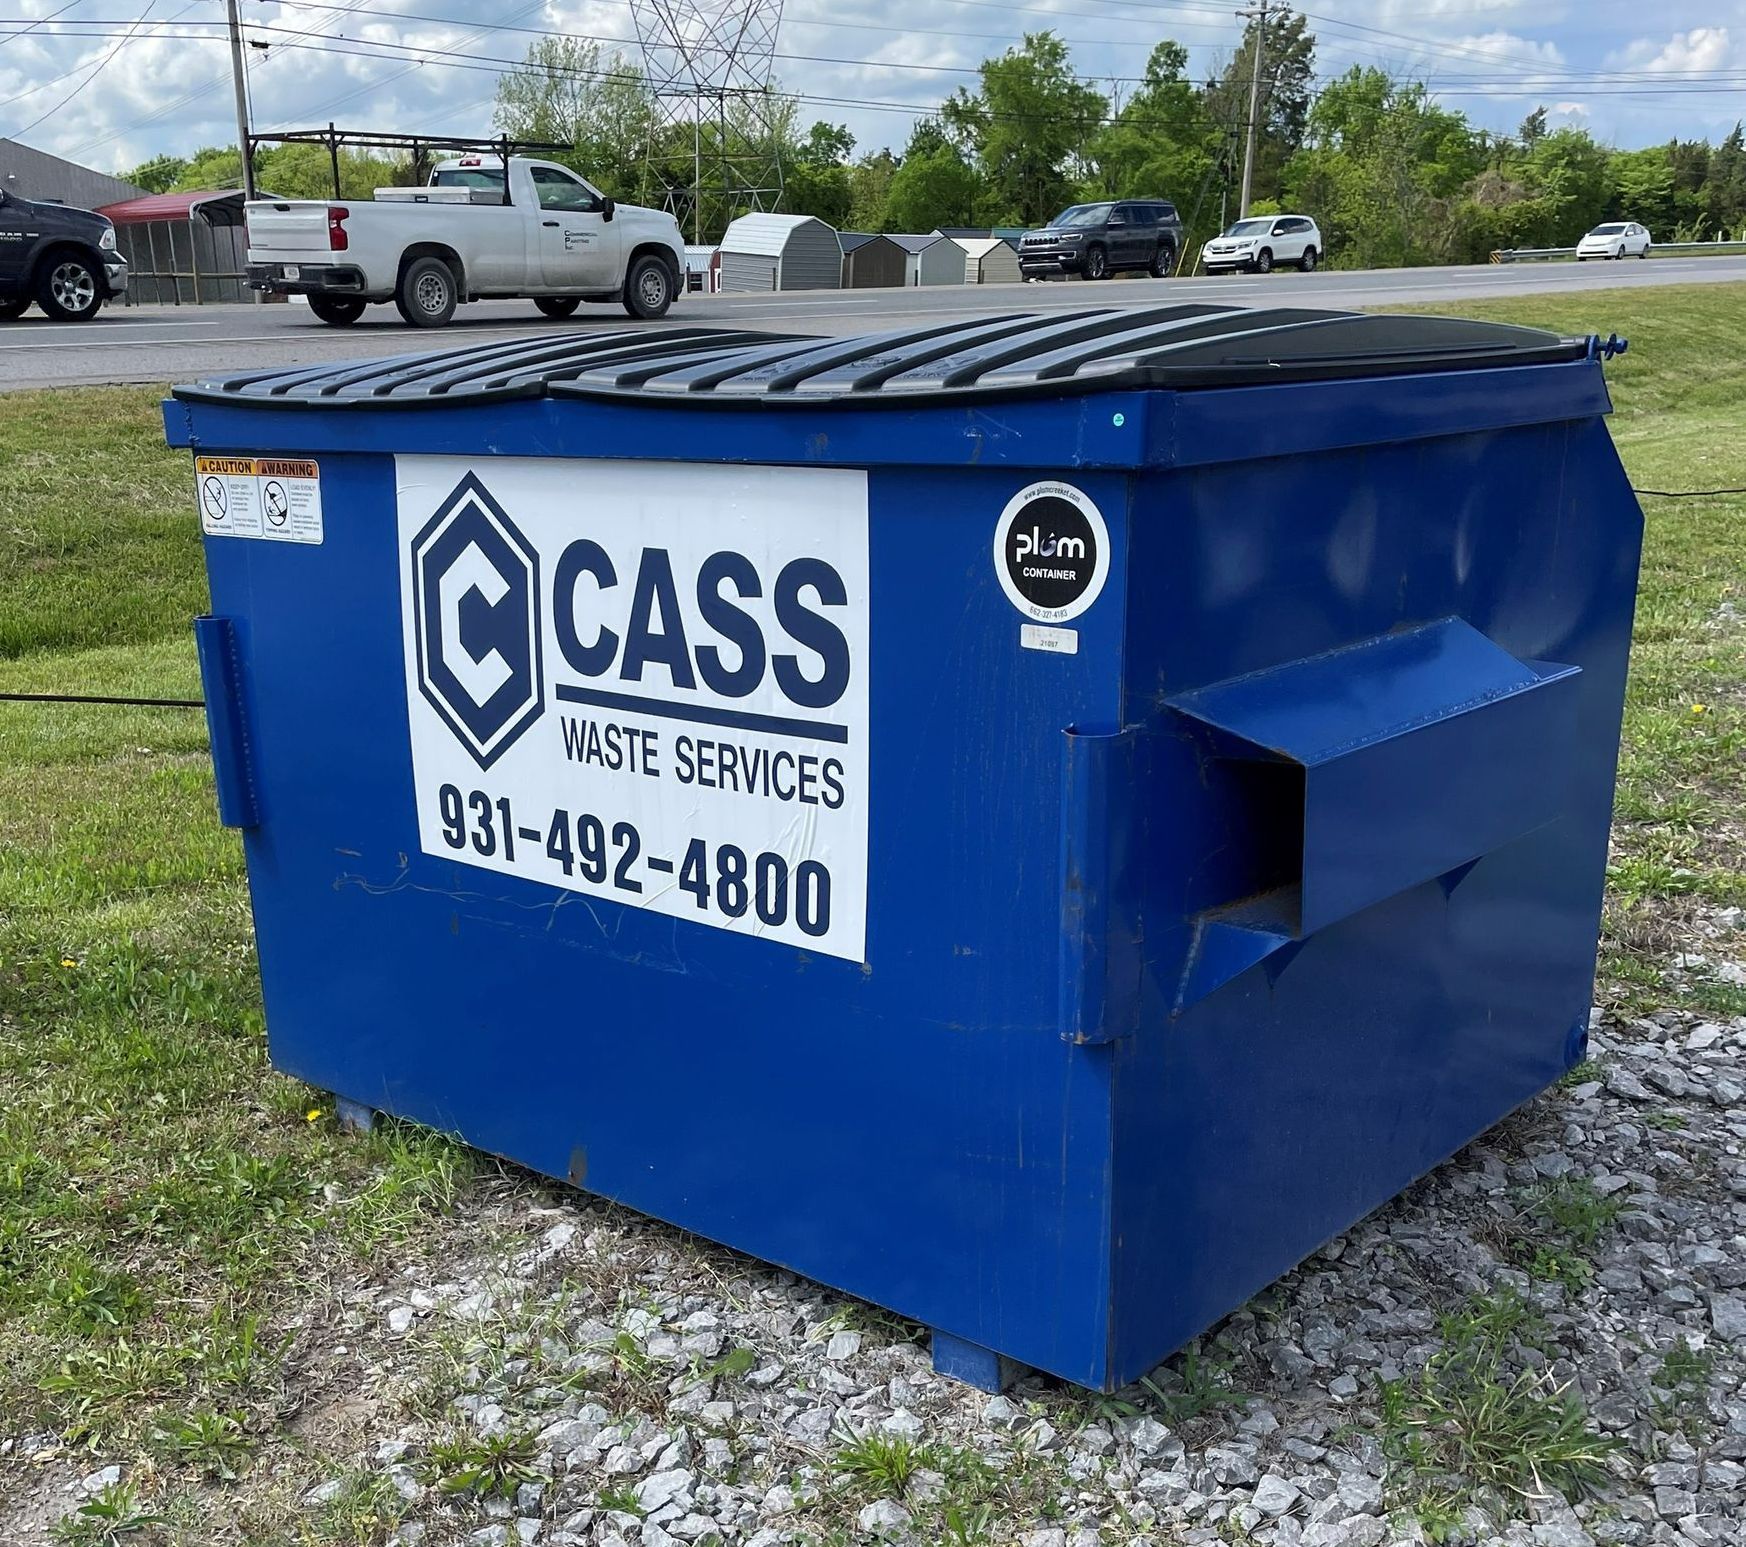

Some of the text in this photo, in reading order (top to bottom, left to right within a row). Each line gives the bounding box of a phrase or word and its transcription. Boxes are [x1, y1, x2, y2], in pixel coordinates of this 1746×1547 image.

[209, 460, 252, 474] CAUTION
[267, 463, 313, 476] WARNING
[1016, 526, 1085, 563] plum
[1023, 567, 1077, 581] CONTAINER
[553, 539, 850, 708] CASS
[561, 716, 845, 810] WASTE SERVICES
[438, 783, 832, 937] 931-492-4800
